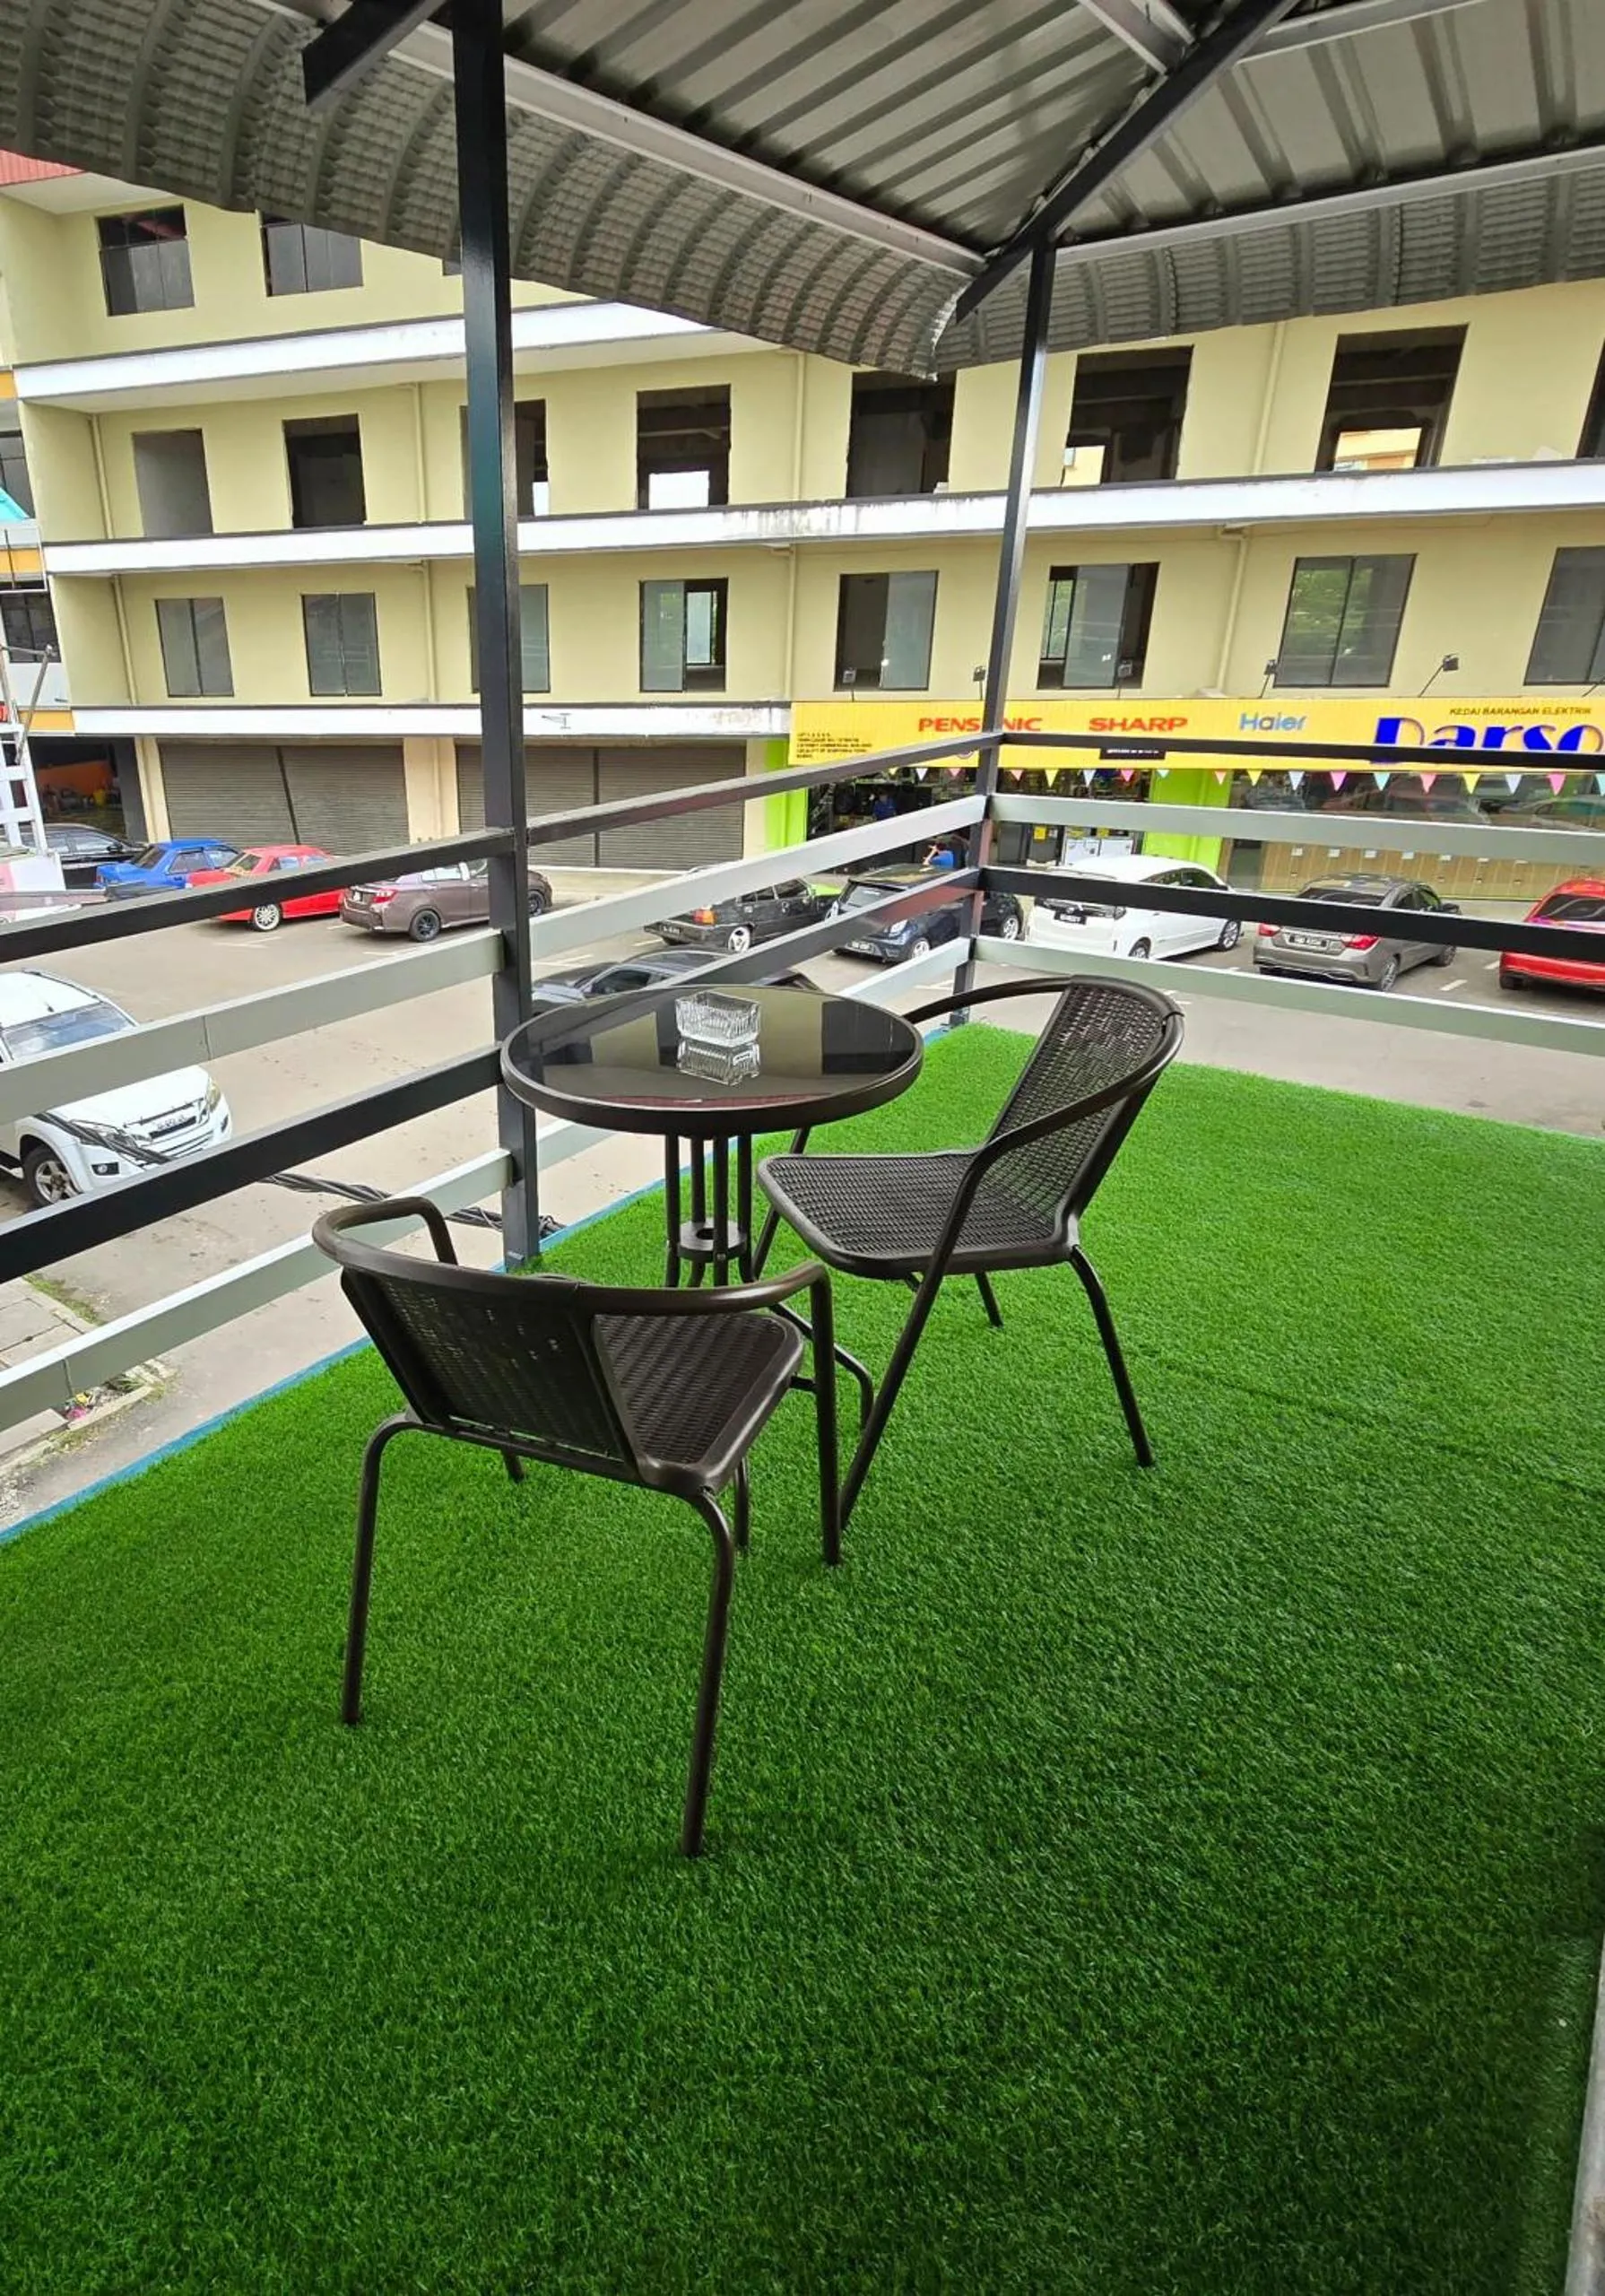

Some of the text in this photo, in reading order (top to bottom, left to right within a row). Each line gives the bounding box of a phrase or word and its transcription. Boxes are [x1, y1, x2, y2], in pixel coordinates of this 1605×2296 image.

[1482, 707, 1540, 716] BARANGAN
[918, 717, 1043, 733] PENSNIC
[1089, 717, 1188, 733] SHARP
[1239, 712, 1306, 731] Haier
